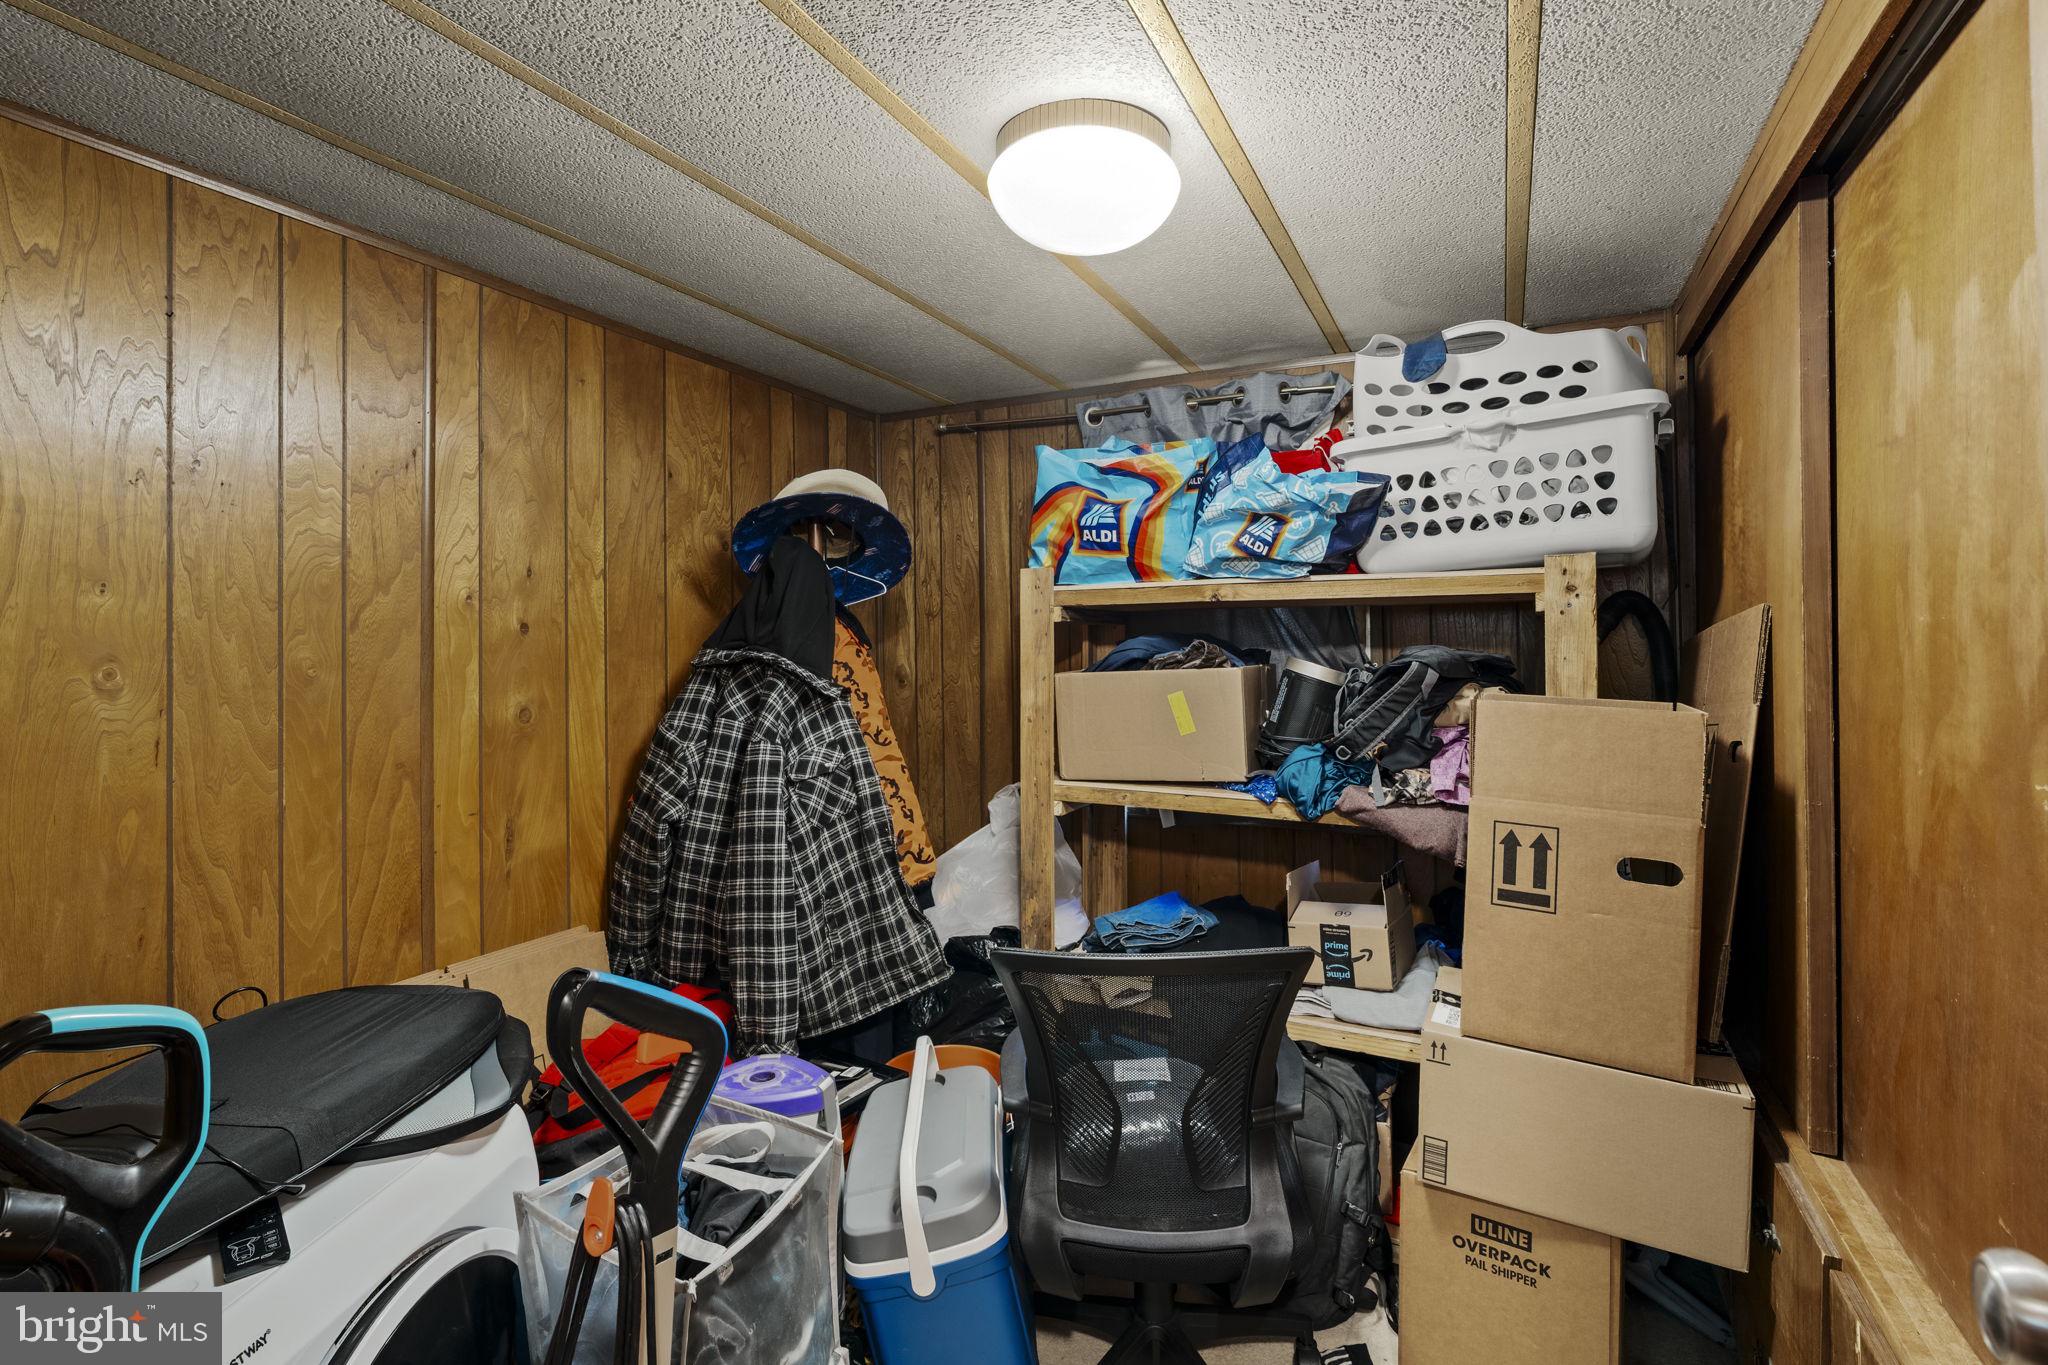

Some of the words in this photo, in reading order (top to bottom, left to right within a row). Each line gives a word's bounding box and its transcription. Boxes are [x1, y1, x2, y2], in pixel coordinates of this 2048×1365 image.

[1082, 529, 1118, 543] ALDI
[1238, 533, 1270, 556] ALDI
[1324, 941, 1349, 951] prime
[1326, 970, 1351, 980] prime
[1474, 1217, 1529, 1249] ULINE
[1452, 1234, 1551, 1279] OVERPACK
[1465, 1254, 1488, 1272] PAIL
[1491, 1263, 1538, 1289] SHIPPER
